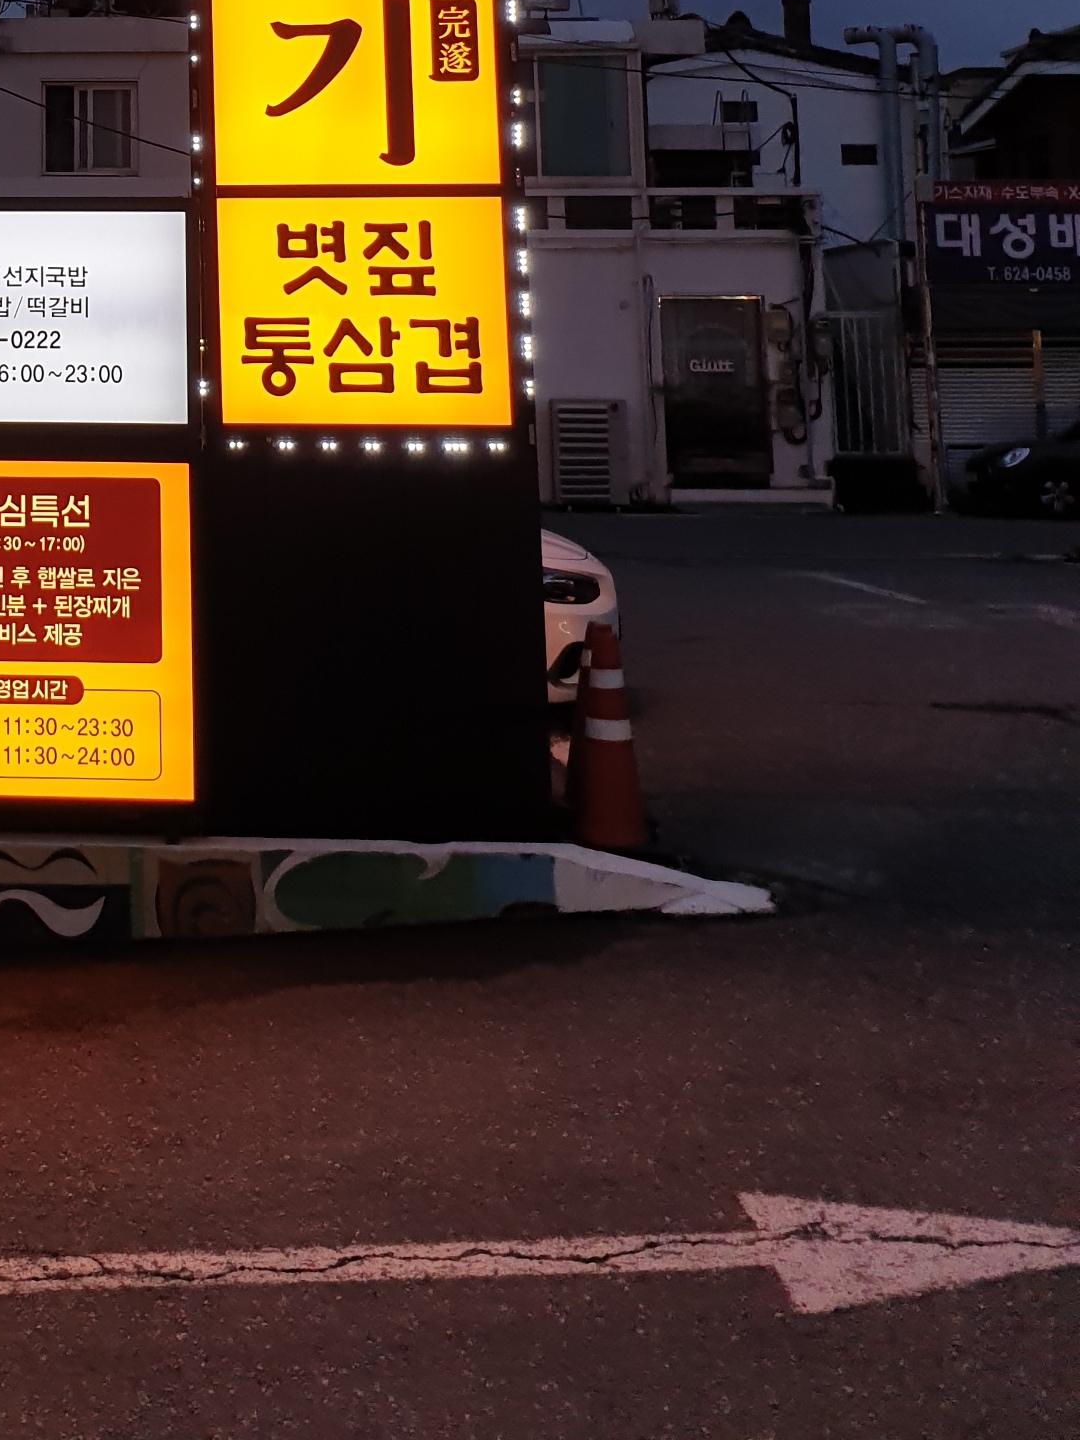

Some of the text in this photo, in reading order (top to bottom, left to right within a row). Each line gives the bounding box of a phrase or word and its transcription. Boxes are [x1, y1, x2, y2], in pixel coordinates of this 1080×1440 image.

[277, 220, 436, 296] 볏짚
[241, 317, 483, 396] 통삼겹
[10, 566, 31, 589] 후
[37, 567, 96, 590] 햅쌀로
[102, 567, 142, 590] 지은
[53, 595, 131, 618] 된장찌개
[42, 623, 83, 646] 제공
[3, 716, 134, 738] 11:30~23:30
[3, 745, 135, 767] 11:30~24:00
